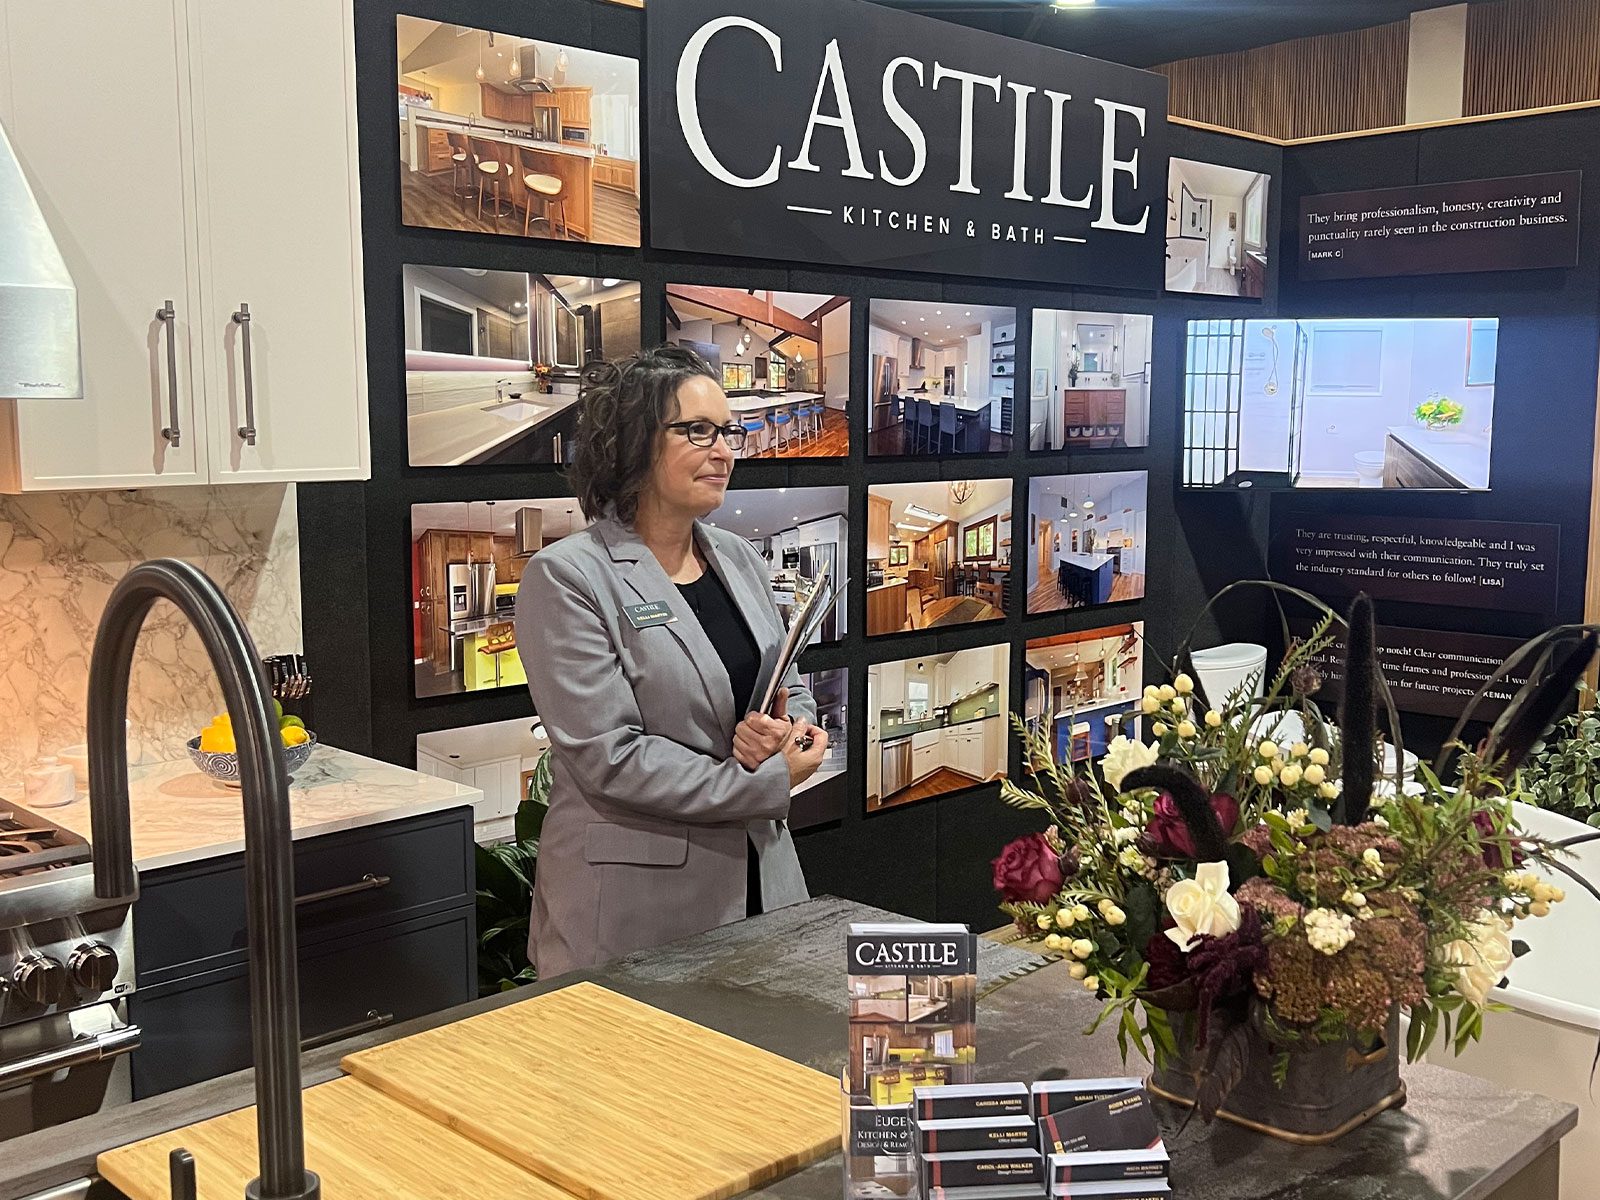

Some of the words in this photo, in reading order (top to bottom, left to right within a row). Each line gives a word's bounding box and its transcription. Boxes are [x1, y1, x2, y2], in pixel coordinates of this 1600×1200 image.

[676, 16, 1149, 235] CASTILE
[1307, 213, 1330, 224] They
[1333, 211, 1358, 222] bring
[1361, 204, 1439, 221] professionalism,
[1442, 202, 1484, 213] honesty,
[1487, 195, 1537, 208] creativity
[1540, 191, 1562, 204] and
[844, 206, 950, 235] KITCHEN
[967, 220, 975, 238] &
[992, 224, 1045, 244] BATH
[1308, 228, 1360, 244] punctuality
[1364, 225, 1391, 238] rarely
[1394, 226, 1415, 235] seen
[1418, 223, 1428, 233] in
[1431, 221, 1447, 232] the
[1450, 217, 1516, 231] construction
[1519, 214, 1568, 226] business.
[1296, 528, 1316, 540] They
[1318, 531, 1332, 539] are
[1334, 531, 1369, 544] trusting,
[1371, 534, 1417, 545] respectful,
[1420, 535, 1486, 549] knowledgeable
[1489, 541, 1507, 550] and
[1517, 543, 1536, 552] was
[1296, 547, 1313, 557] very
[1315, 547, 1356, 558] impressed
[1359, 550, 1378, 560] with
[1380, 550, 1400, 561] their
[1403, 554, 1475, 566] communication.
[1478, 557, 1502, 570] They
[1505, 560, 1528, 571] truly
[1531, 562, 1545, 571] set
[1295, 562, 1309, 572] the
[1311, 562, 1345, 576] industry
[1347, 567, 1384, 578] standard
[1386, 568, 1400, 578] for
[1402, 570, 1430, 581] others
[1432, 573, 1442, 581] to
[1444, 572, 1476, 584] follow!
[1386, 646, 1412, 656] notch!
[1414, 648, 1436, 658] Clear
[1382, 661, 1401, 671] time
[1402, 662, 1430, 675] frames
[1432, 668, 1448, 676] and
[1400, 679, 1413, 688] for
[1415, 681, 1440, 692] future
[855, 942, 959, 966] CASTILE
[857, 1130, 898, 1139] KITCHEN
